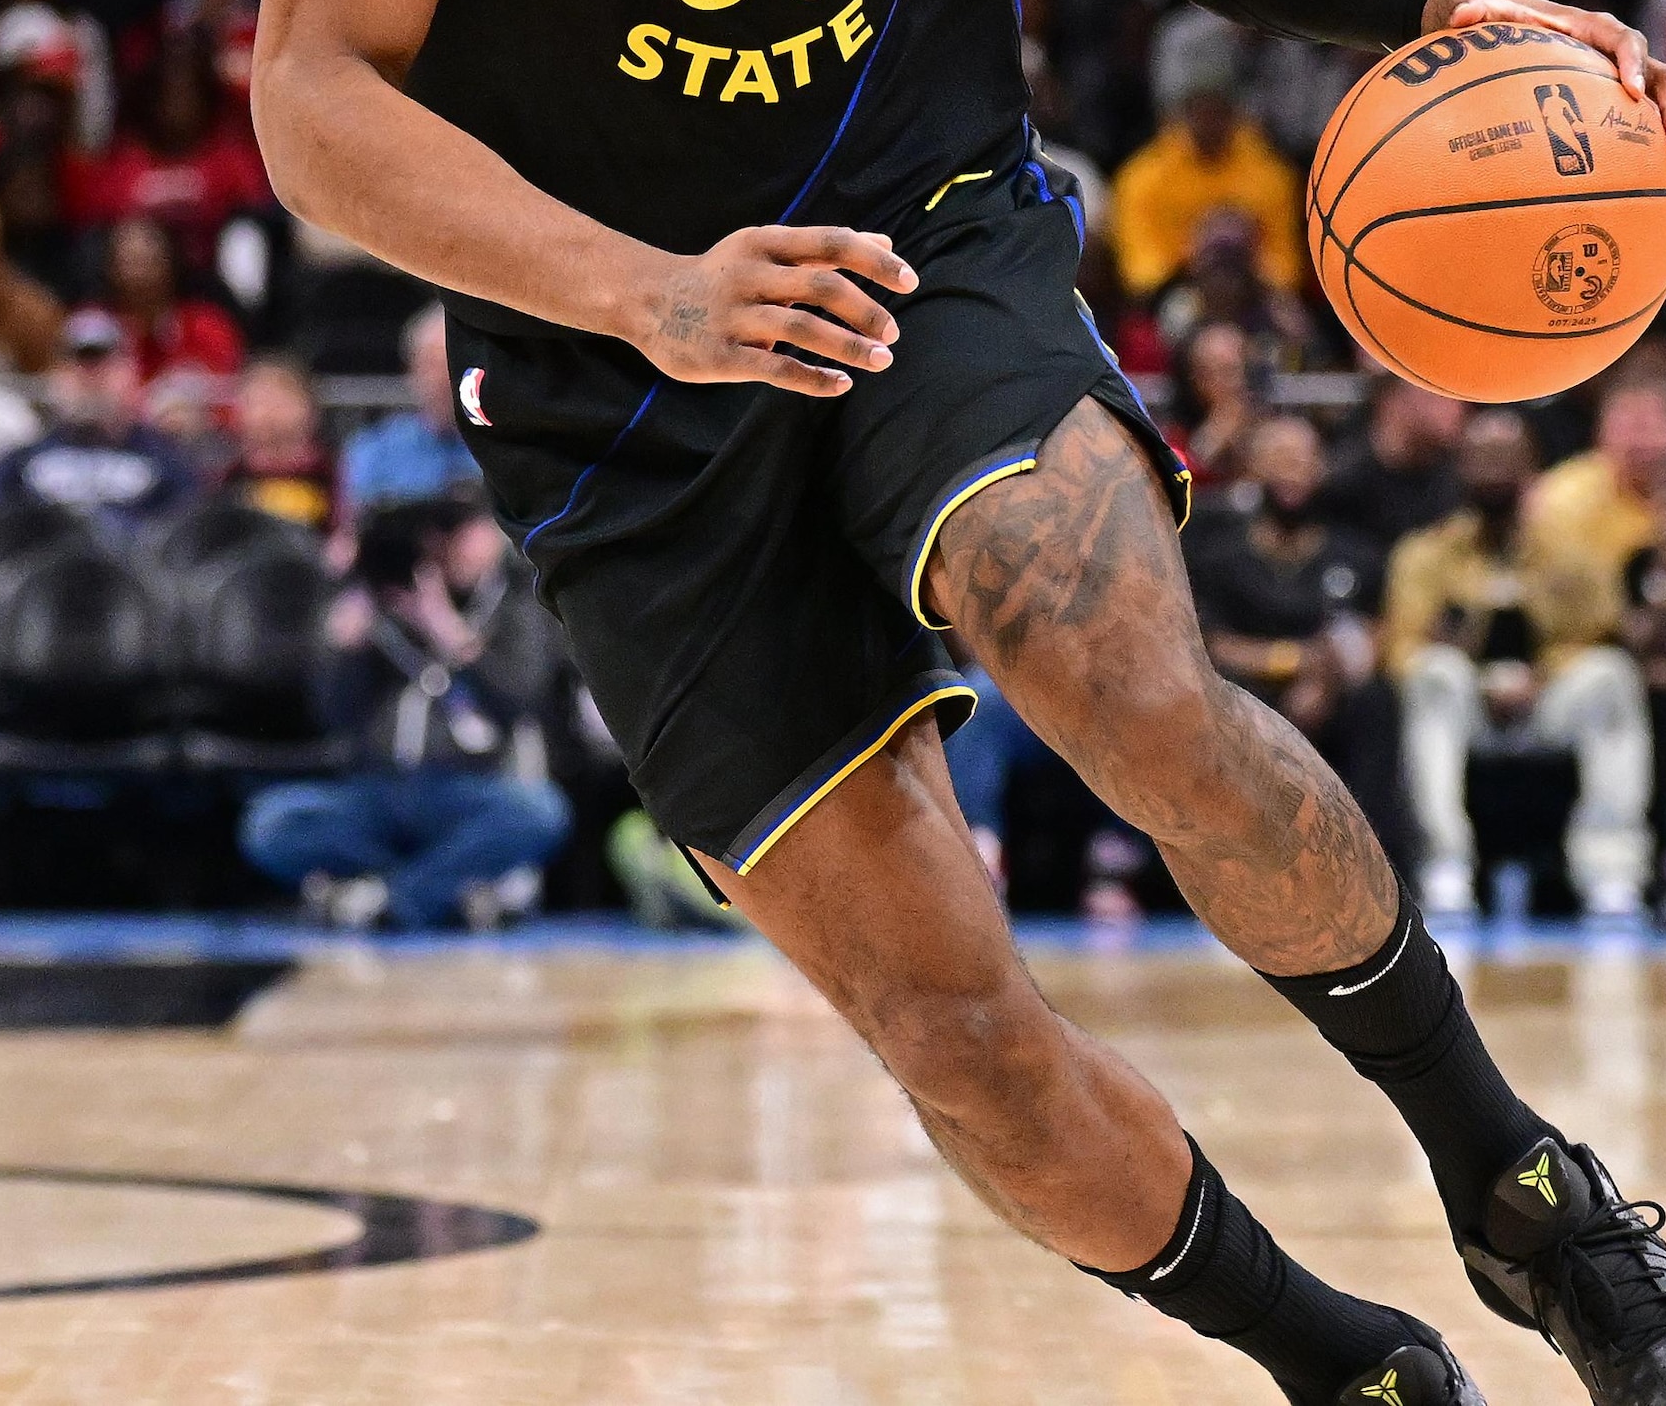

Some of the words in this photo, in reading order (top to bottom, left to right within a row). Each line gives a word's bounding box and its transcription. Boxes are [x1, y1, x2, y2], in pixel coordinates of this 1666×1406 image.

[1448, 130, 1488, 153] OFFICIAL
[1487, 124, 1513, 141] GAME
[1512, 119, 1535, 135] BALL
